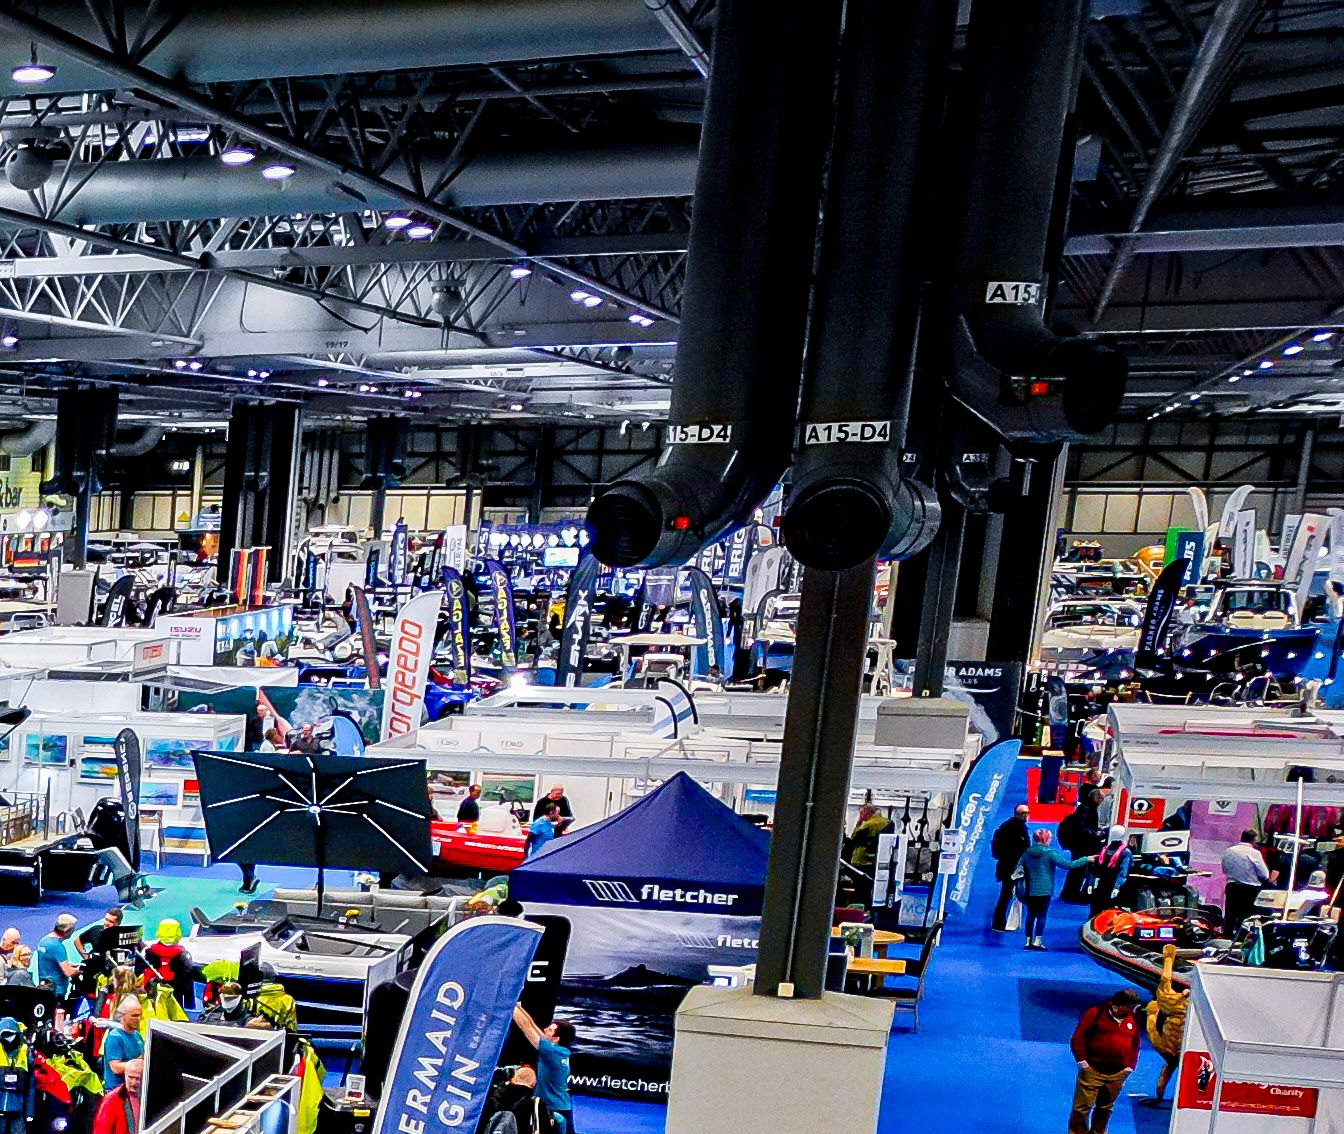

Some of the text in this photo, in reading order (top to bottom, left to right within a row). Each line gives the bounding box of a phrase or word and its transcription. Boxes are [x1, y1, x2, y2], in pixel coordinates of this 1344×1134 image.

[668, 425, 730, 443] 15-D4
[806, 423, 890, 442] A15-D4
[728, 529, 745, 577] BRIG
[170, 626, 202, 634] ISUZU
[959, 667, 1003, 678] ADAMS
[984, 772, 1005, 803] Boat
[641, 883, 739, 907] fletcher
[437, 1053, 481, 1128] GIN
[1269, 1087, 1305, 1099] Charity
